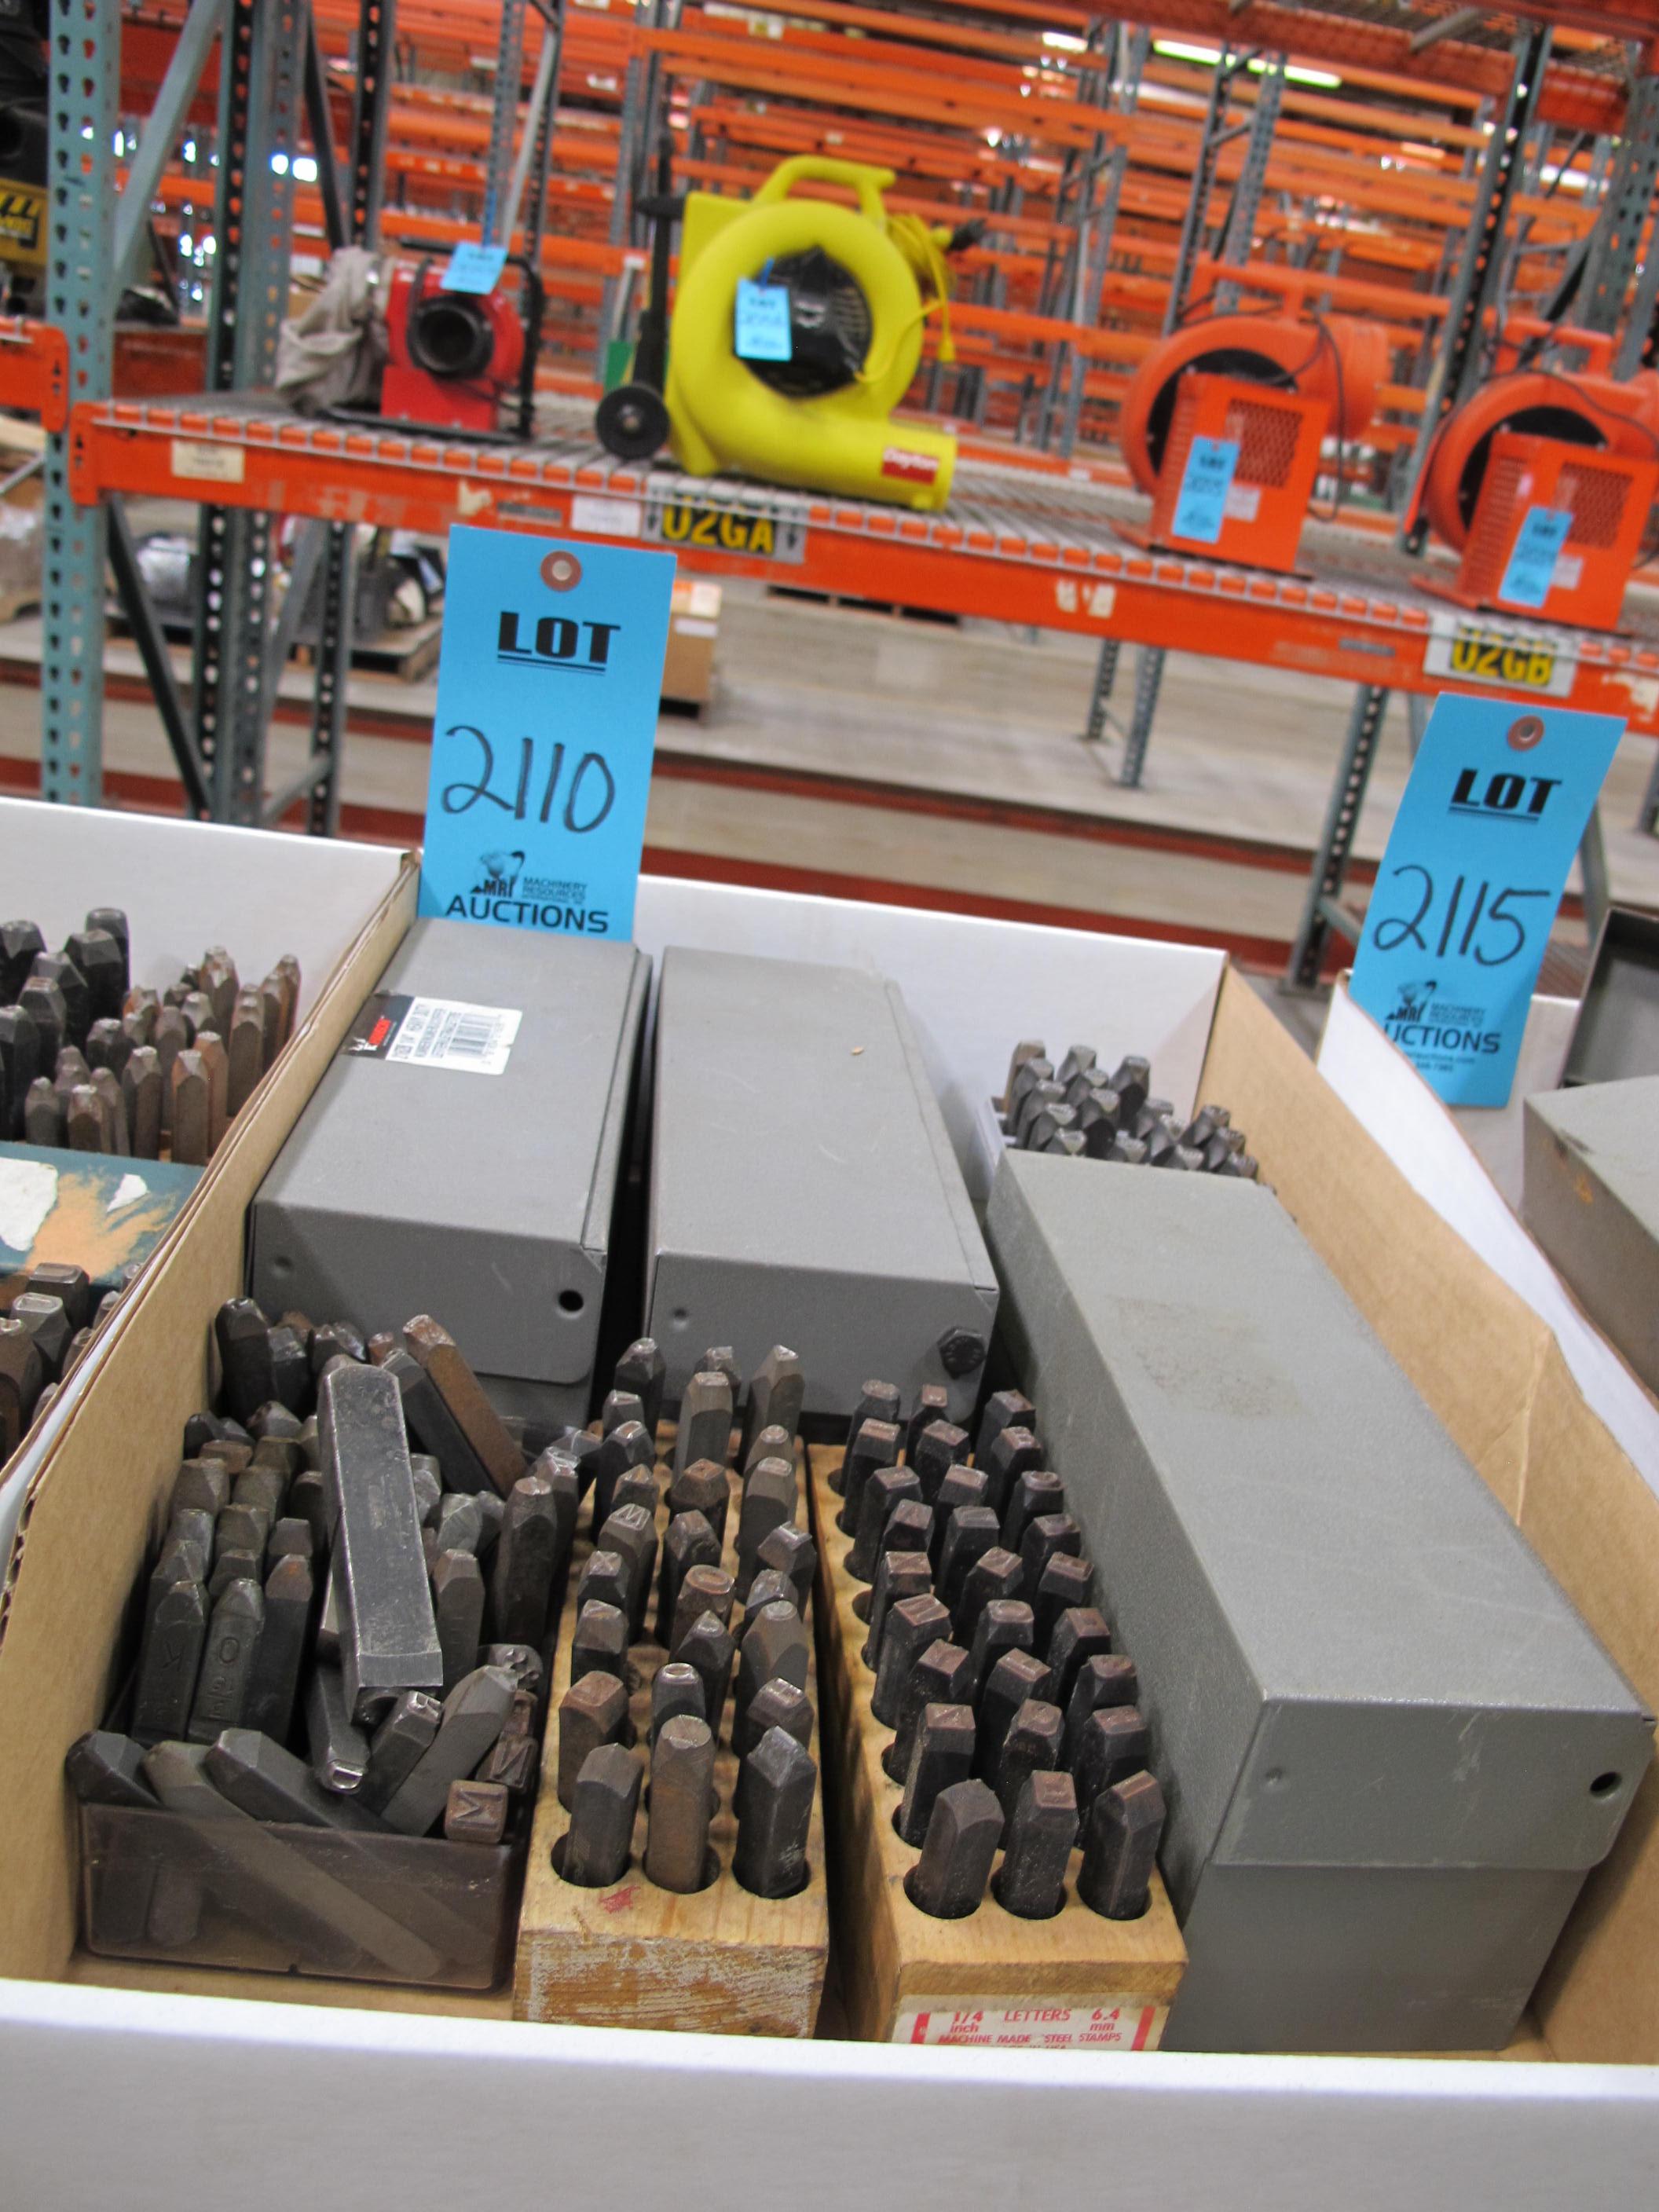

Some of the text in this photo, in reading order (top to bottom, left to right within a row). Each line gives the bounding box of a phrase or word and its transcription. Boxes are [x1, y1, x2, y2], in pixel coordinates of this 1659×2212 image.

[498, 610, 621, 665] LOT
[441, 725, 615, 833] 2110
[1450, 768, 1562, 815] LOT
[445, 895, 610, 933] AUCTIONS
[1373, 865, 1551, 966] 2115
[1384, 1024, 1501, 1054] UCTIONS
[950, 2022, 1115, 2033] inch mm
[954, 2008, 1120, 2024] 1/4 LETTERS 6.4
[938, 2031, 1122, 2045] MACHINE MADE STEEL STAMPS
